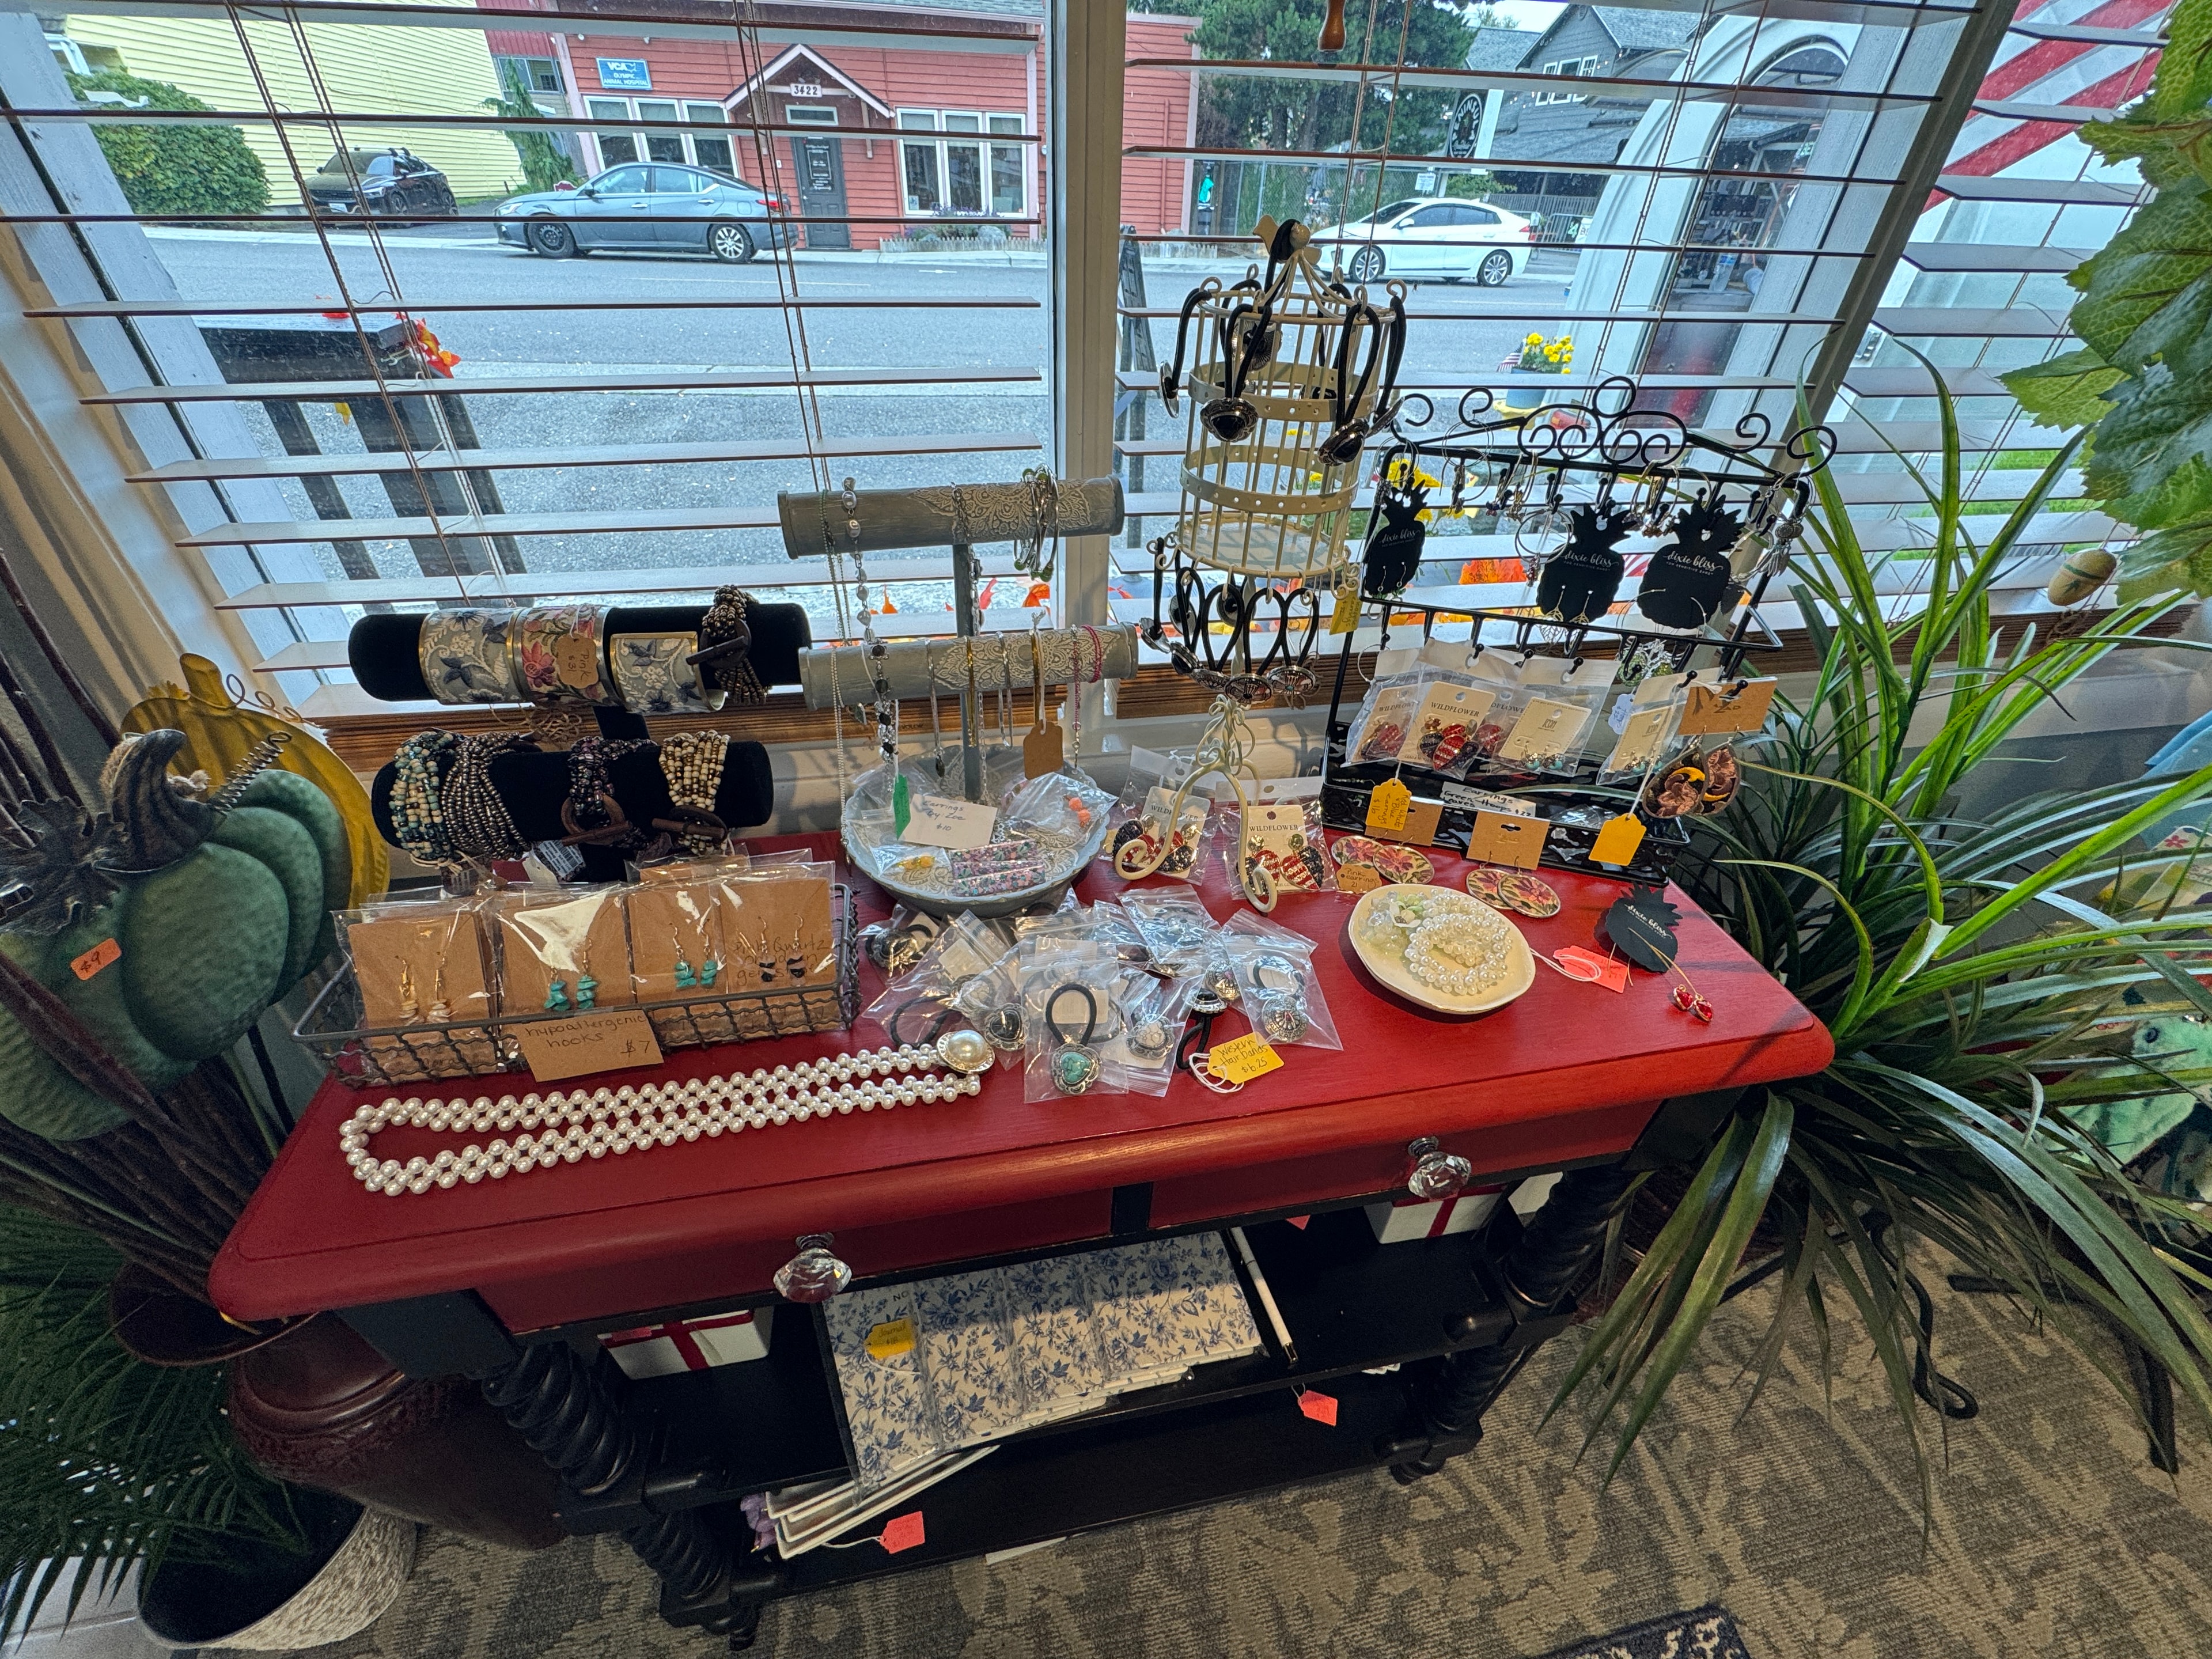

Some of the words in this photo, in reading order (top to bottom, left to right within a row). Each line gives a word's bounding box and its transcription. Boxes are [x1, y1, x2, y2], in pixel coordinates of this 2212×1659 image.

[607, 62, 627, 71] VCA
[794, 85, 818, 96] 3422
[1378, 533, 1399, 544] dixie
[1559, 550, 1589, 562] dixie
[1590, 554, 1619, 568] bliss
[1662, 550, 1692, 564] dixie
[1693, 555, 1724, 572] bliss
[579, 650, 592, 680] Pink
[1430, 702, 1480, 717] WILDFLOWER
[1444, 790, 1474, 802] Green
[945, 812, 966, 821] Zoe
[937, 823, 952, 831] $10
[1344, 868, 1366, 877] Pink
[1346, 875, 1380, 889] earrings
[1624, 904, 1647, 922] dixie
[80, 950, 101, 974] $9
[525, 1015, 646, 1036] hypoallergenic
[547, 1033, 604, 1048] hooks
[620, 1039, 650, 1058] $7
[1241, 1056, 1268, 1073] $6.25
